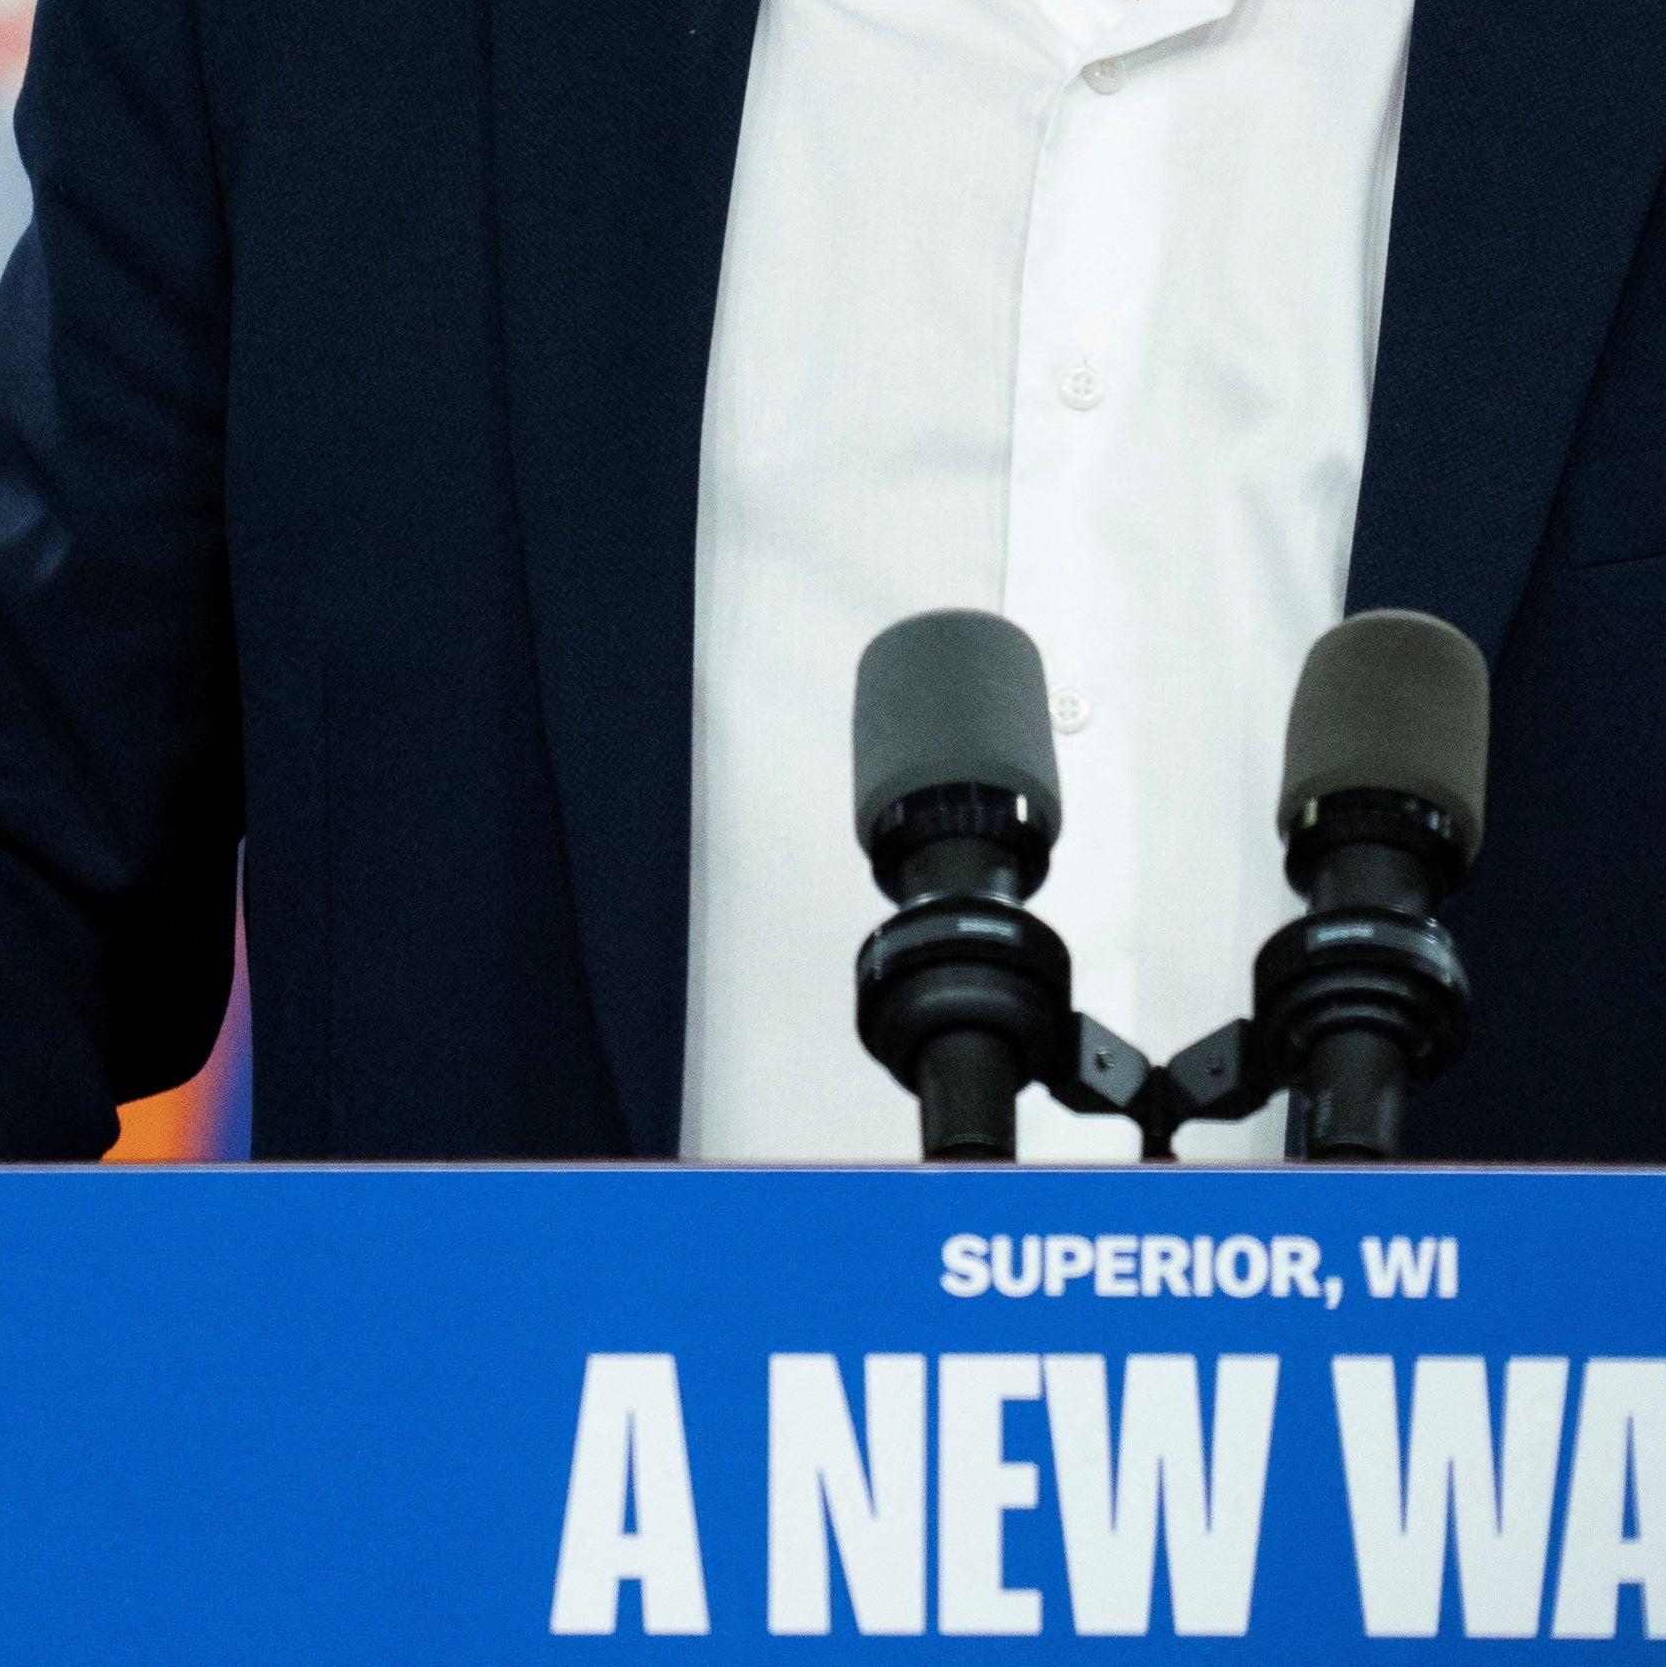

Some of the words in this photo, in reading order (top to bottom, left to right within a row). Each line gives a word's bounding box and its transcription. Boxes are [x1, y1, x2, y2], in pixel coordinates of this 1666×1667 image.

[939, 1233, 1344, 1311] SUPERIOR,
[1360, 1235, 1460, 1300] WI
[548, 1352, 711, 1637] A
[766, 1352, 1281, 1638] NEW
